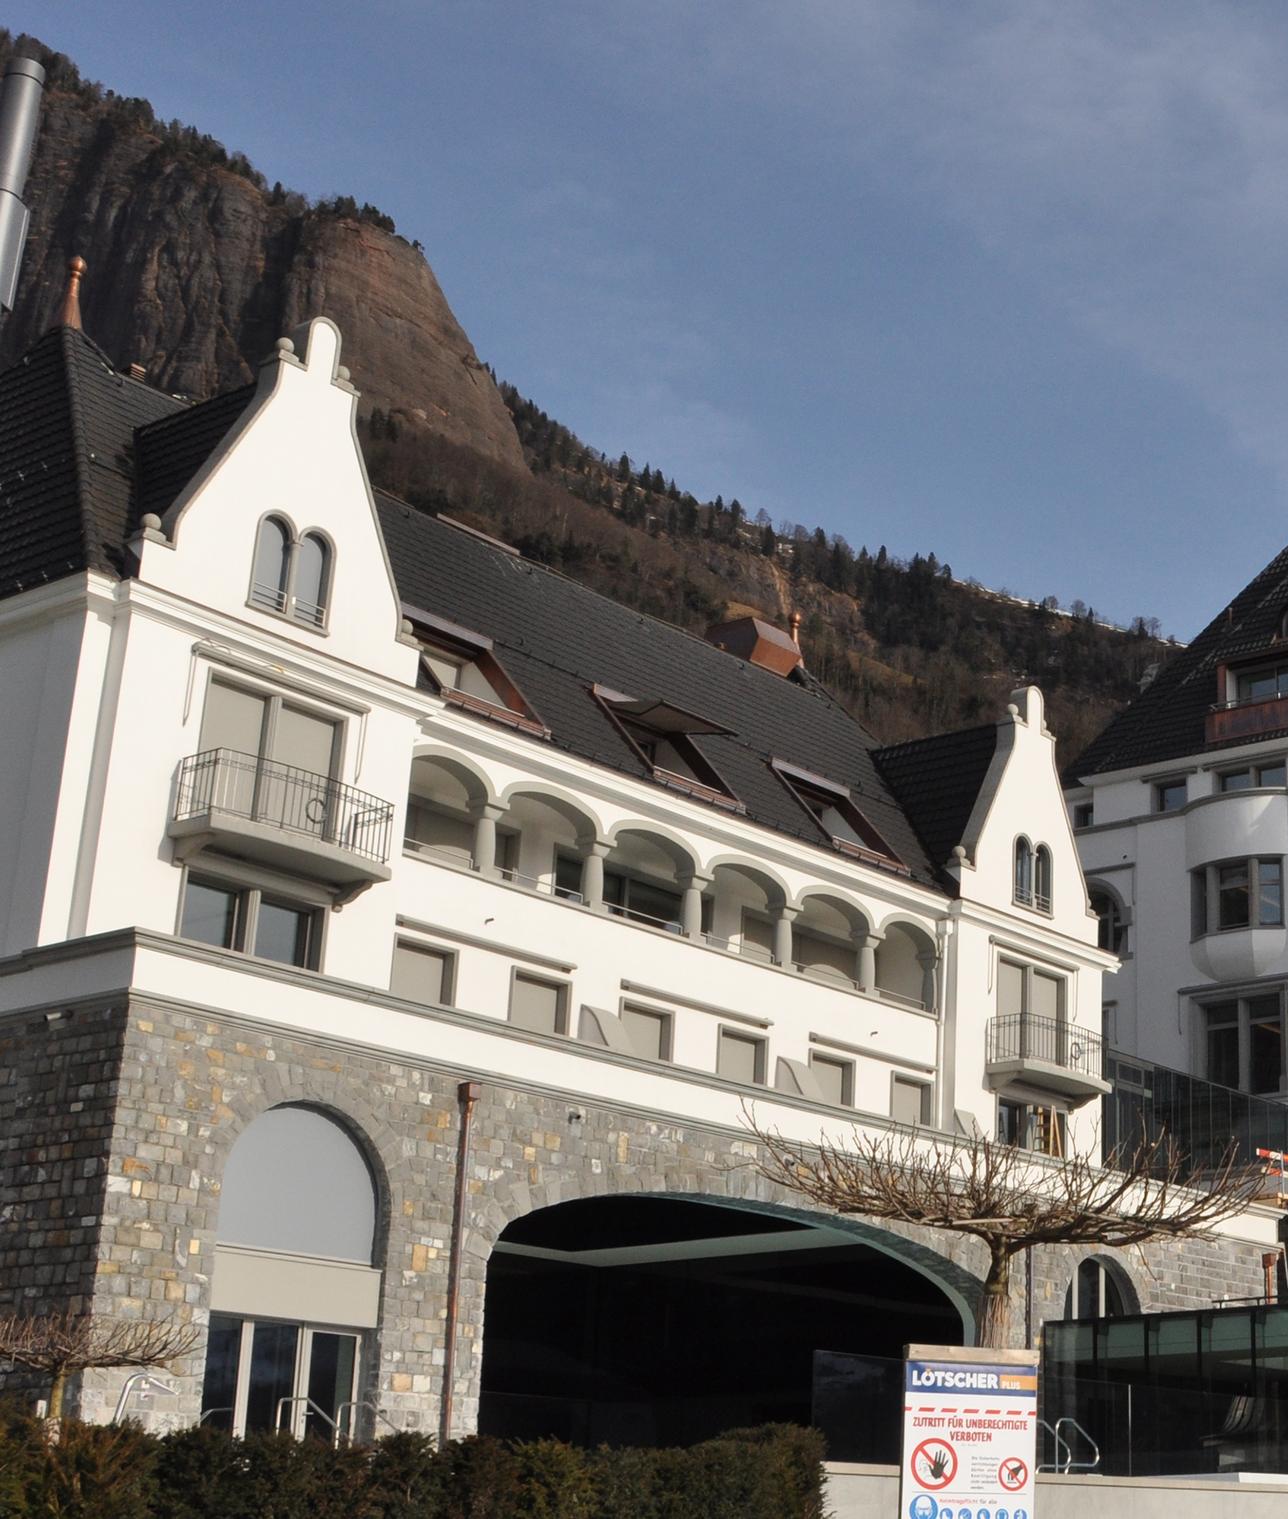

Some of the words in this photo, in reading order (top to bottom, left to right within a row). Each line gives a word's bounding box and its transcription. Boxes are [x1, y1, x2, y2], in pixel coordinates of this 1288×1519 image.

[912, 1368, 998, 1389] LÖTSCHER
[1001, 1381, 1020, 1390] PLUS
[913, 1416, 945, 1427] ZUTRITT
[948, 1415, 964, 1428] FÜR
[965, 1418, 1028, 1430] UNBERECHTIGTE
[950, 1431, 992, 1442] VERBOTEN
